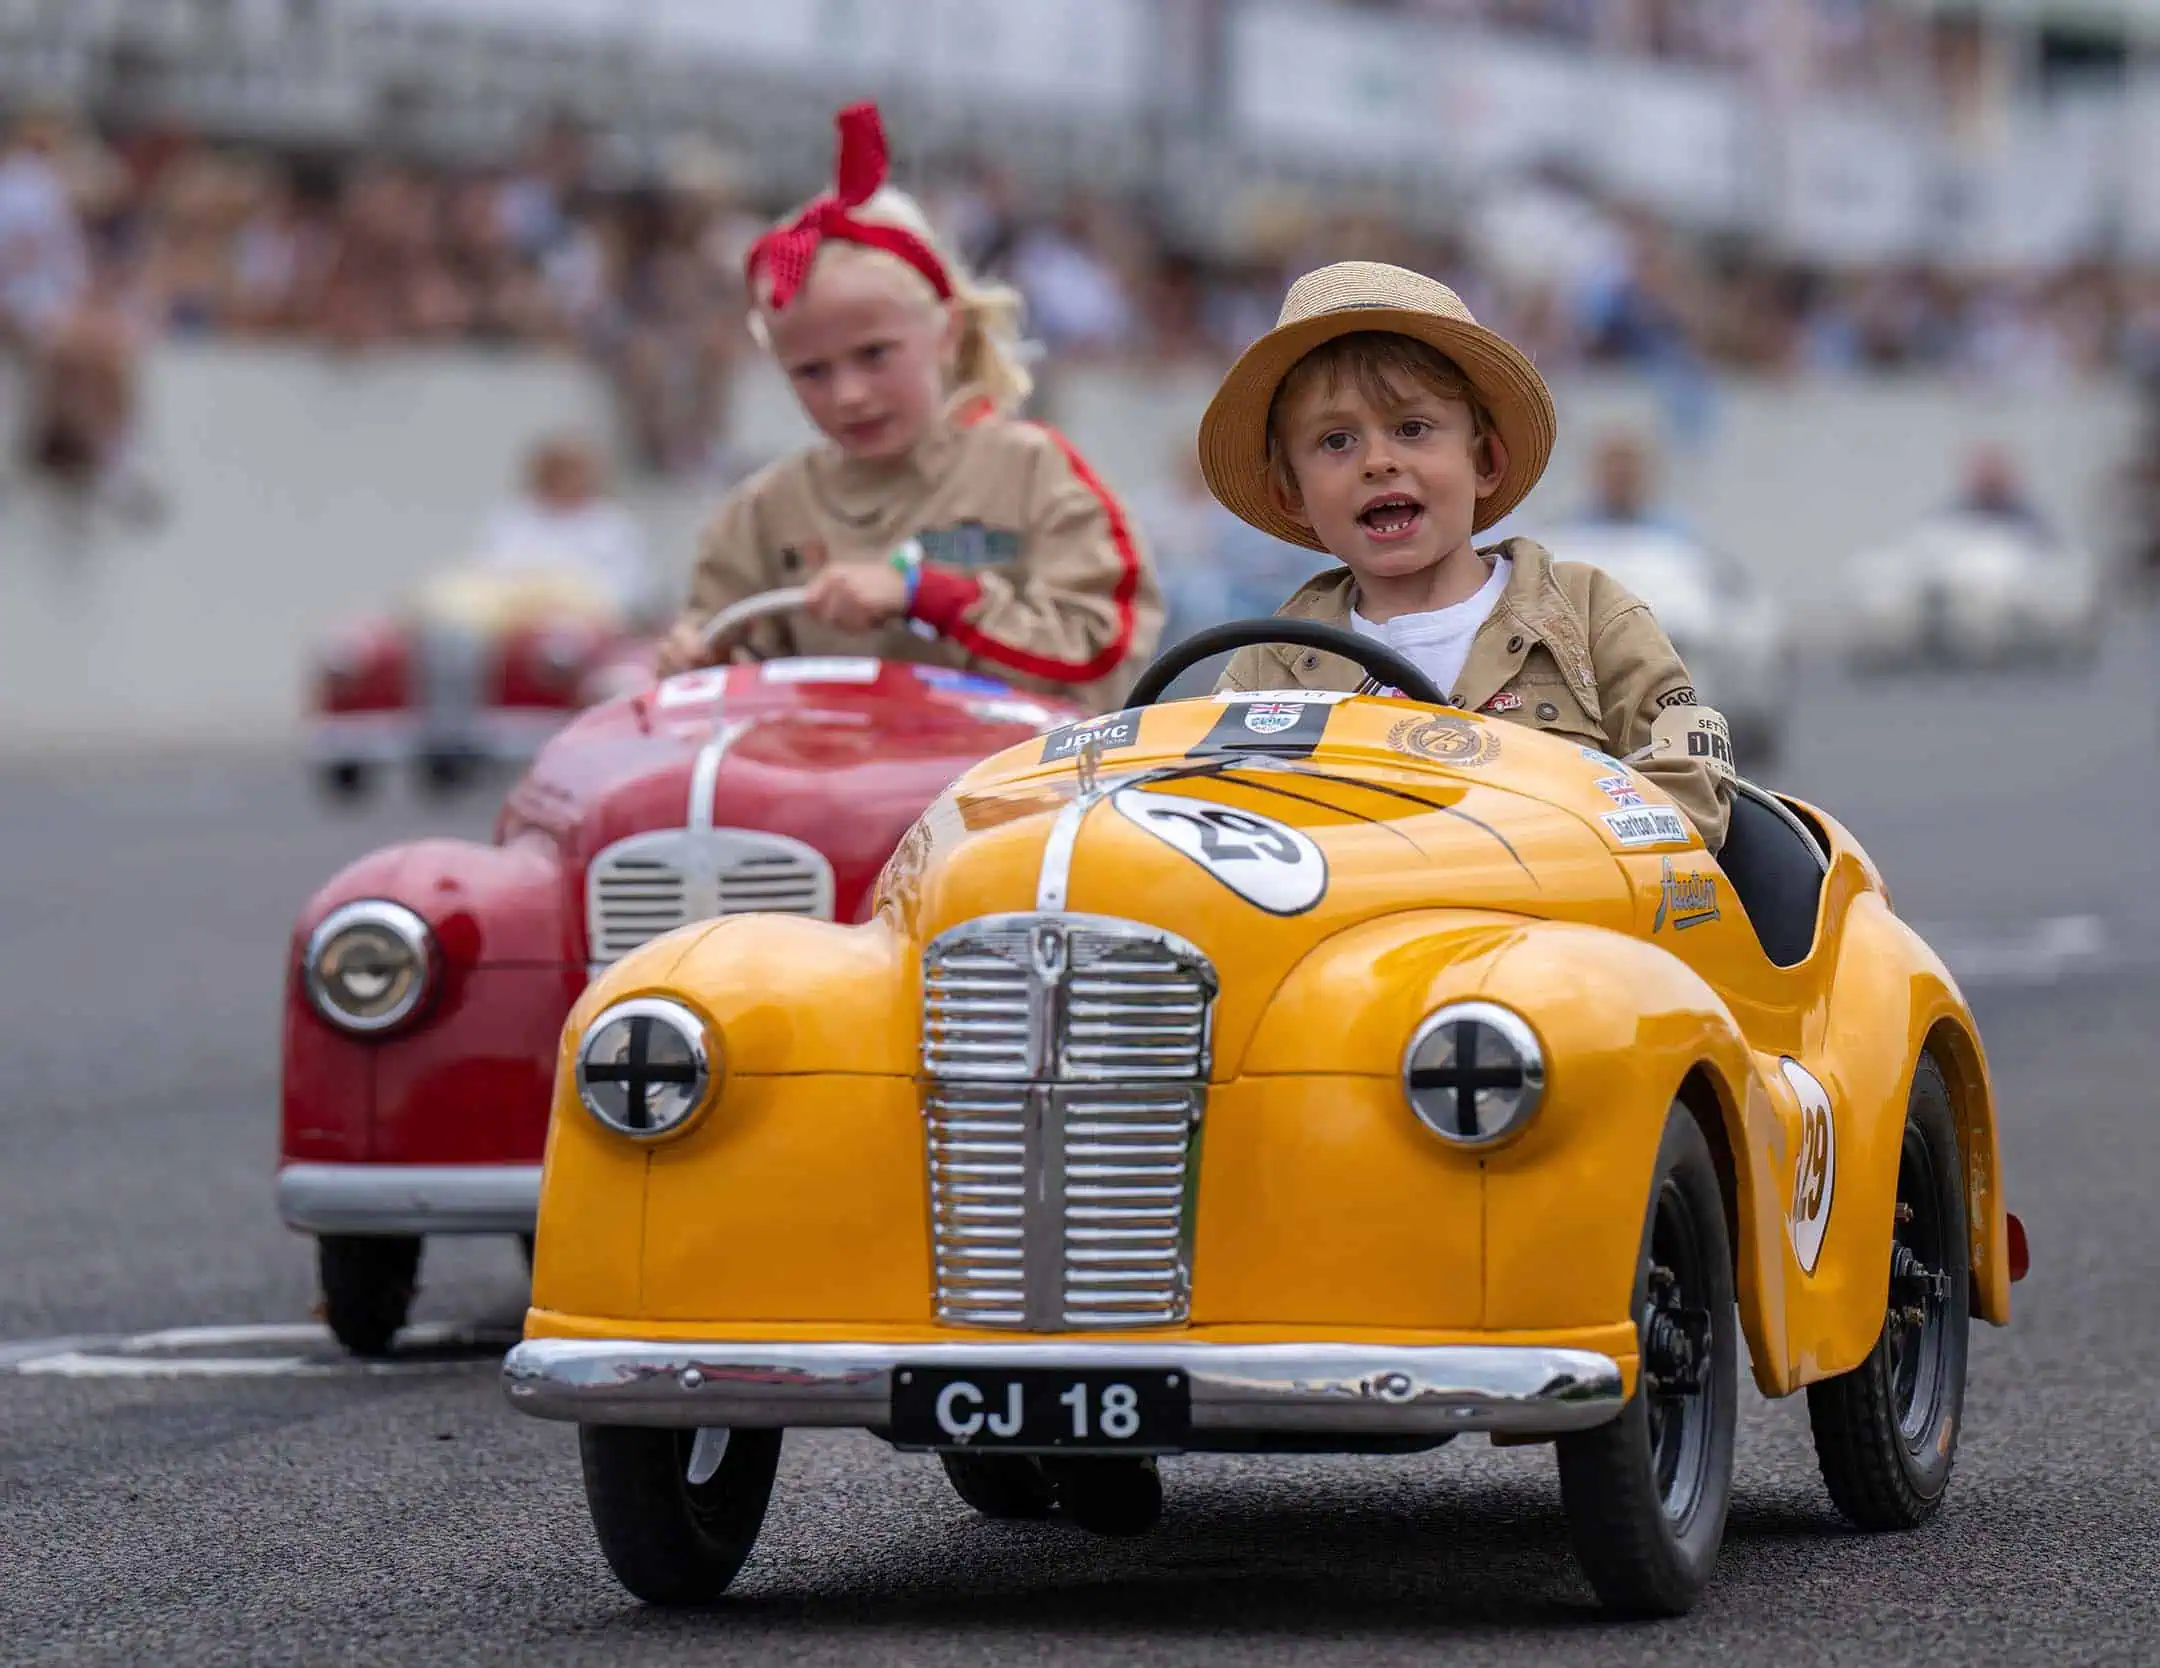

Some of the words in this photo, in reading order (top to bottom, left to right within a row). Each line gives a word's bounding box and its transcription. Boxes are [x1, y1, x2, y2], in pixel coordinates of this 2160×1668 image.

[1055, 724, 1129, 752] JBVC
[1146, 810, 1302, 865] 29
[935, 1381, 1024, 1438] CJ
[1060, 1382, 1141, 1439] 18
